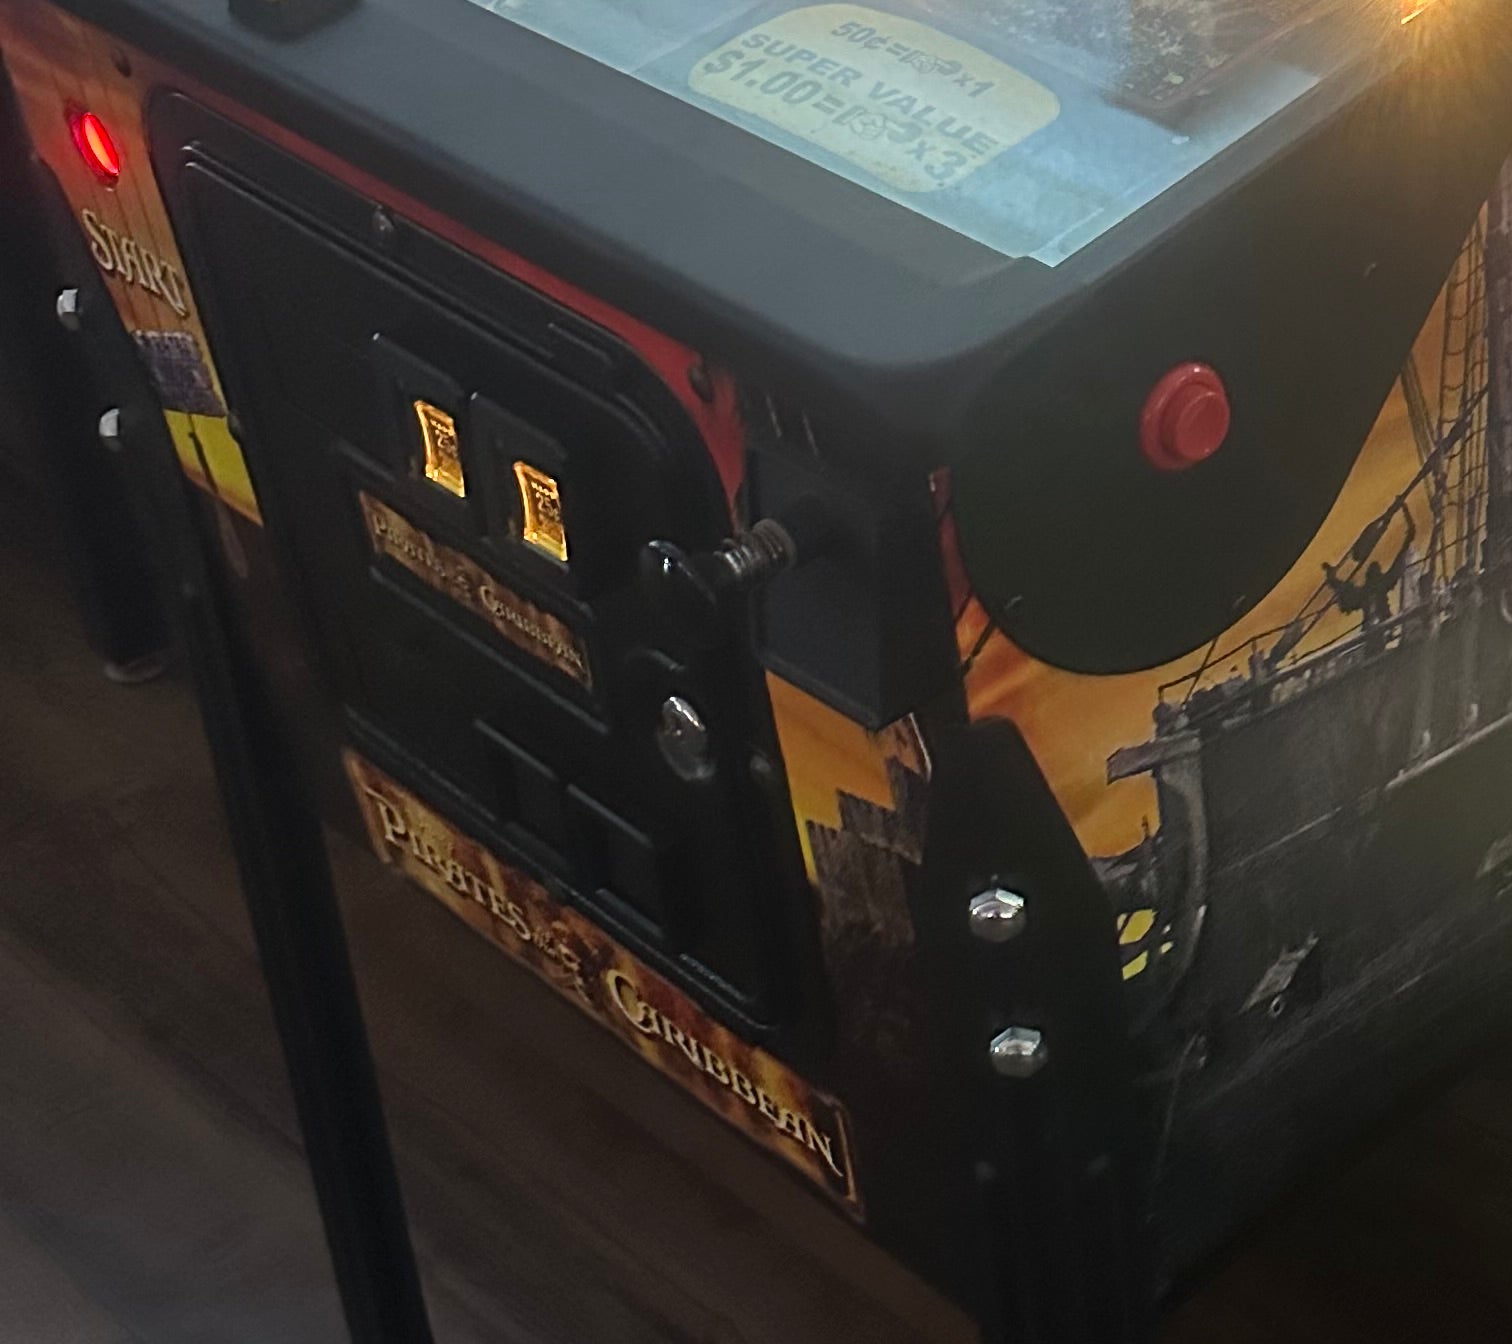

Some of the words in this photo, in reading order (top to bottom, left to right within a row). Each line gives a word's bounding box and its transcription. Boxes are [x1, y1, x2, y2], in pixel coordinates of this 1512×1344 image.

[742, 31, 863, 89] SUPER
[867, 80, 1001, 157] VALUE
[82, 207, 188, 317] START
[606, 968, 844, 1178] CARIBBEAN
